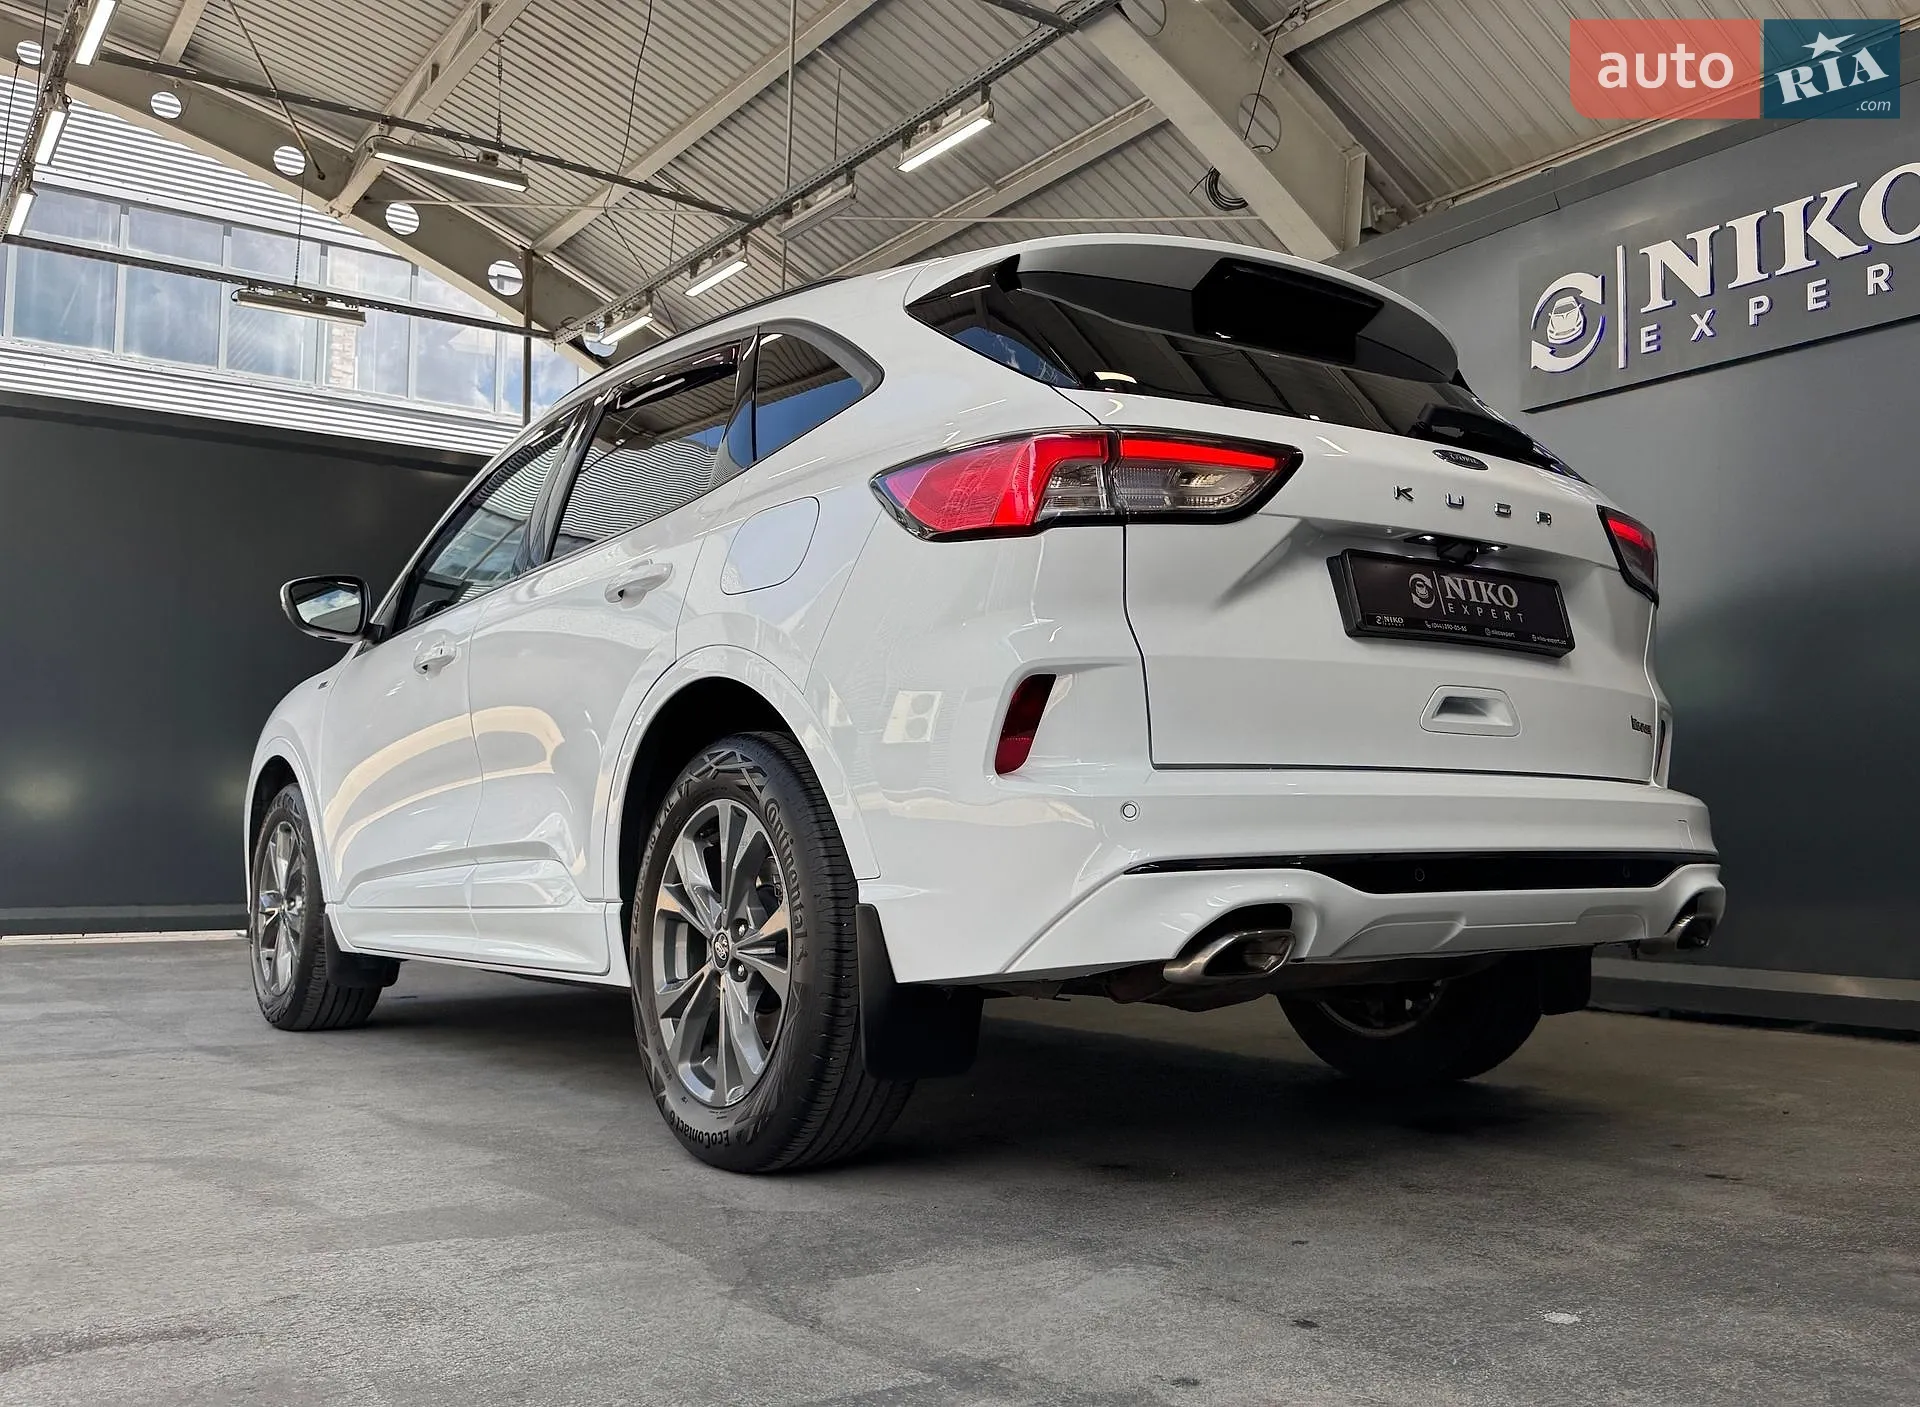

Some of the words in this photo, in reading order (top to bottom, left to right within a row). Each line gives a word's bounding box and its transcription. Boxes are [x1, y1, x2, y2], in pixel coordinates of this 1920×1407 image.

[1440, 574, 1519, 608] NIKO
[1383, 615, 1404, 624] NIKO
[1447, 602, 1527, 623] EXPERT
[764, 797, 808, 939] Continental
[675, 1115, 730, 1149] EcoContact
